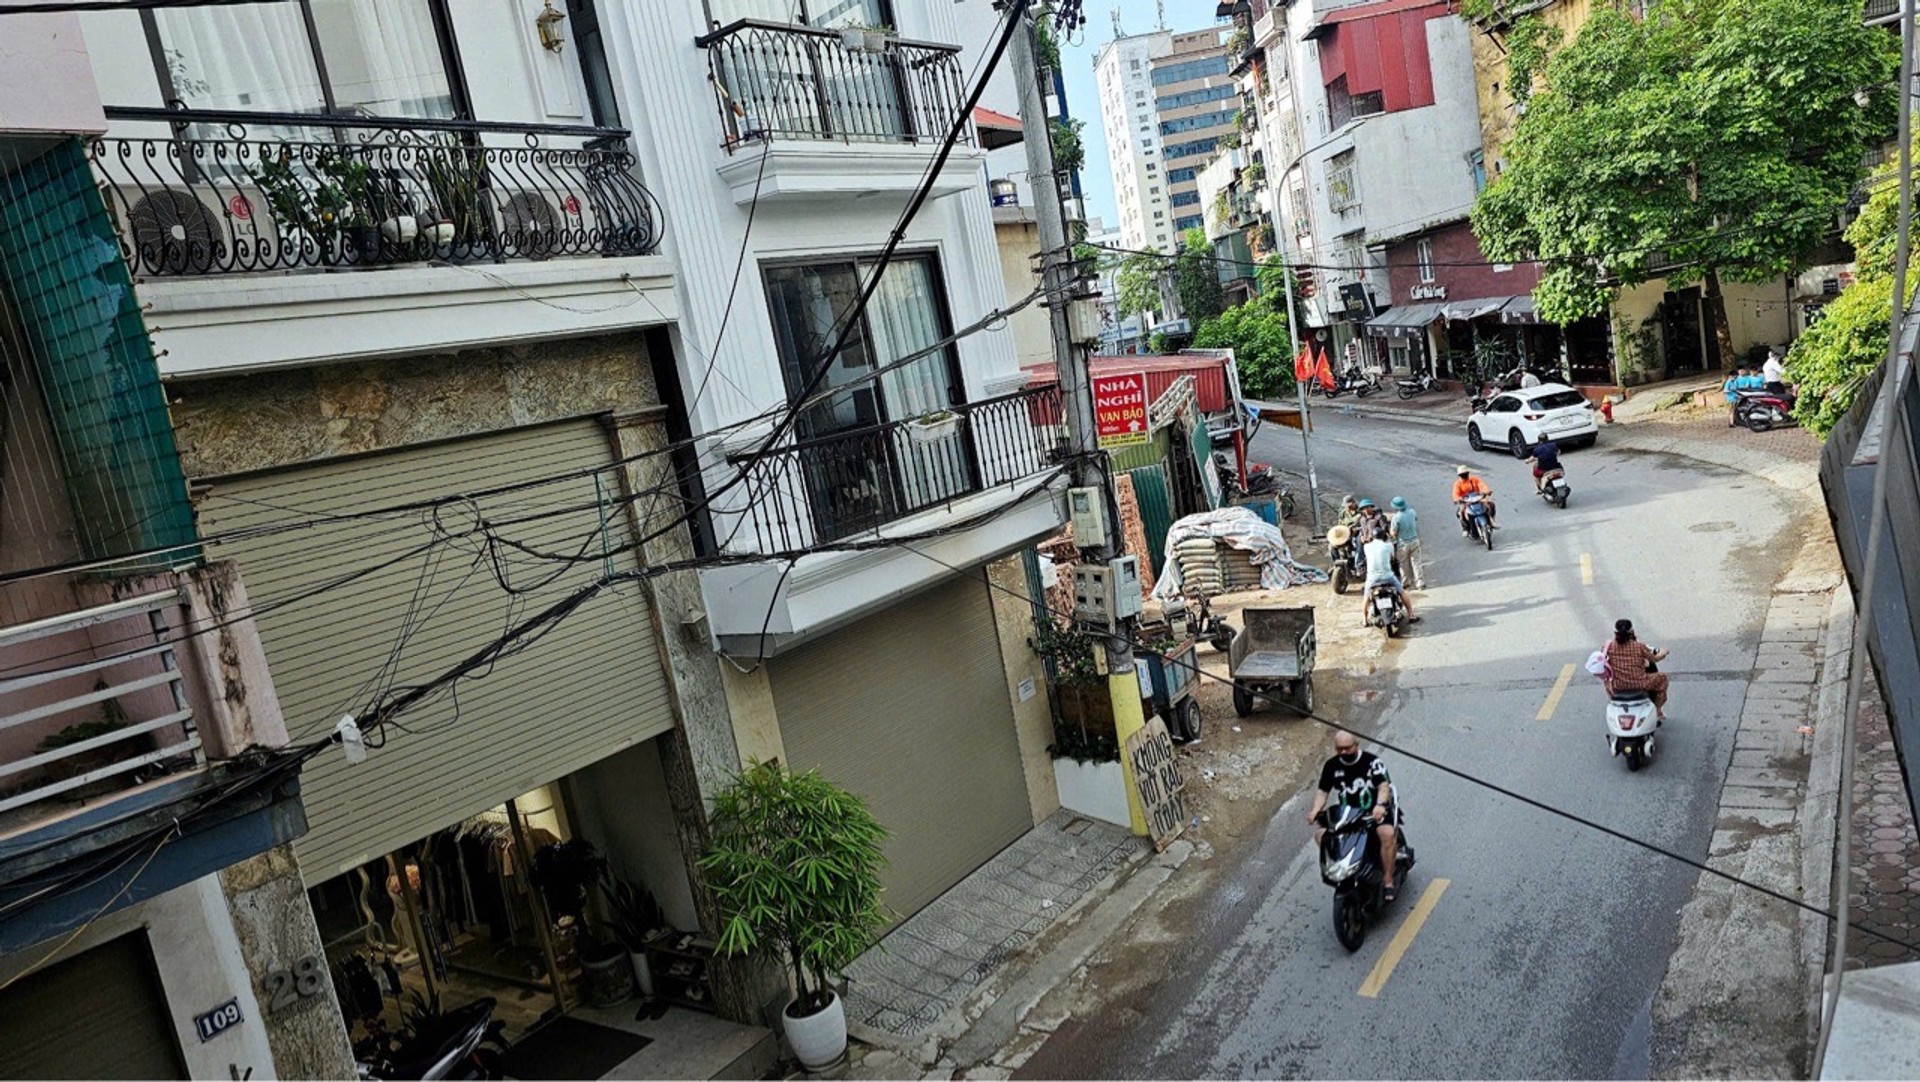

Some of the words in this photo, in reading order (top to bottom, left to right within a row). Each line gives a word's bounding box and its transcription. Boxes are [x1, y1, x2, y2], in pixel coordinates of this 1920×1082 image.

[1098, 390, 1142, 407] NGHỈ
[1099, 377, 1138, 392] NHÀ
[1099, 411, 1121, 425] VẠN
[1133, 731, 1172, 776] KHÔNG
[1160, 757, 1184, 794] RÁC
[265, 955, 324, 1015] 28
[202, 1005, 240, 1036] 109
